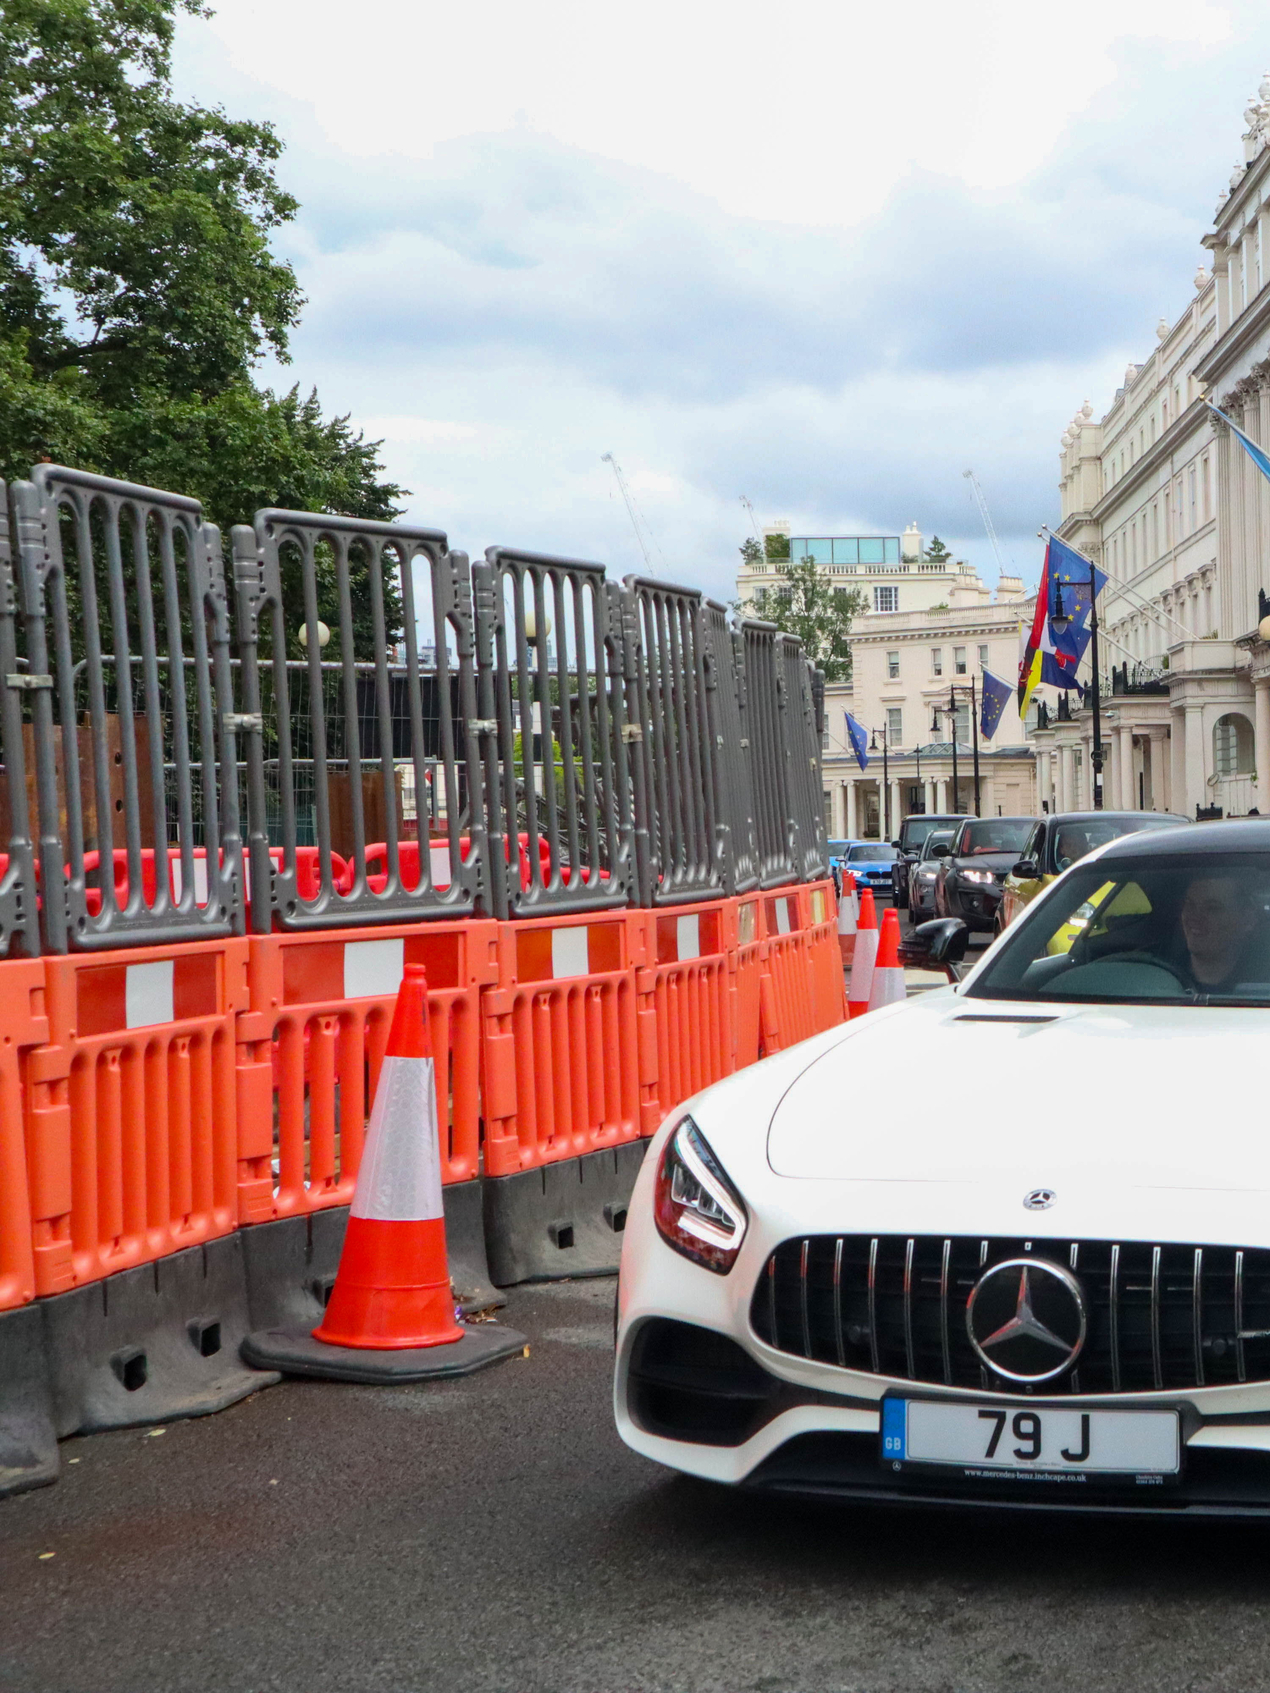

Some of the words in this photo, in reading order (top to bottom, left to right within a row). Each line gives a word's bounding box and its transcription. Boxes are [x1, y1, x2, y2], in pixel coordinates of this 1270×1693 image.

[977, 1409, 1043, 1461] 79
[1059, 1413, 1090, 1462] J
[884, 1436, 902, 1451] GB
[964, 1469, 1087, 1483] www.mercedes-benz.inchcape.co.uk
